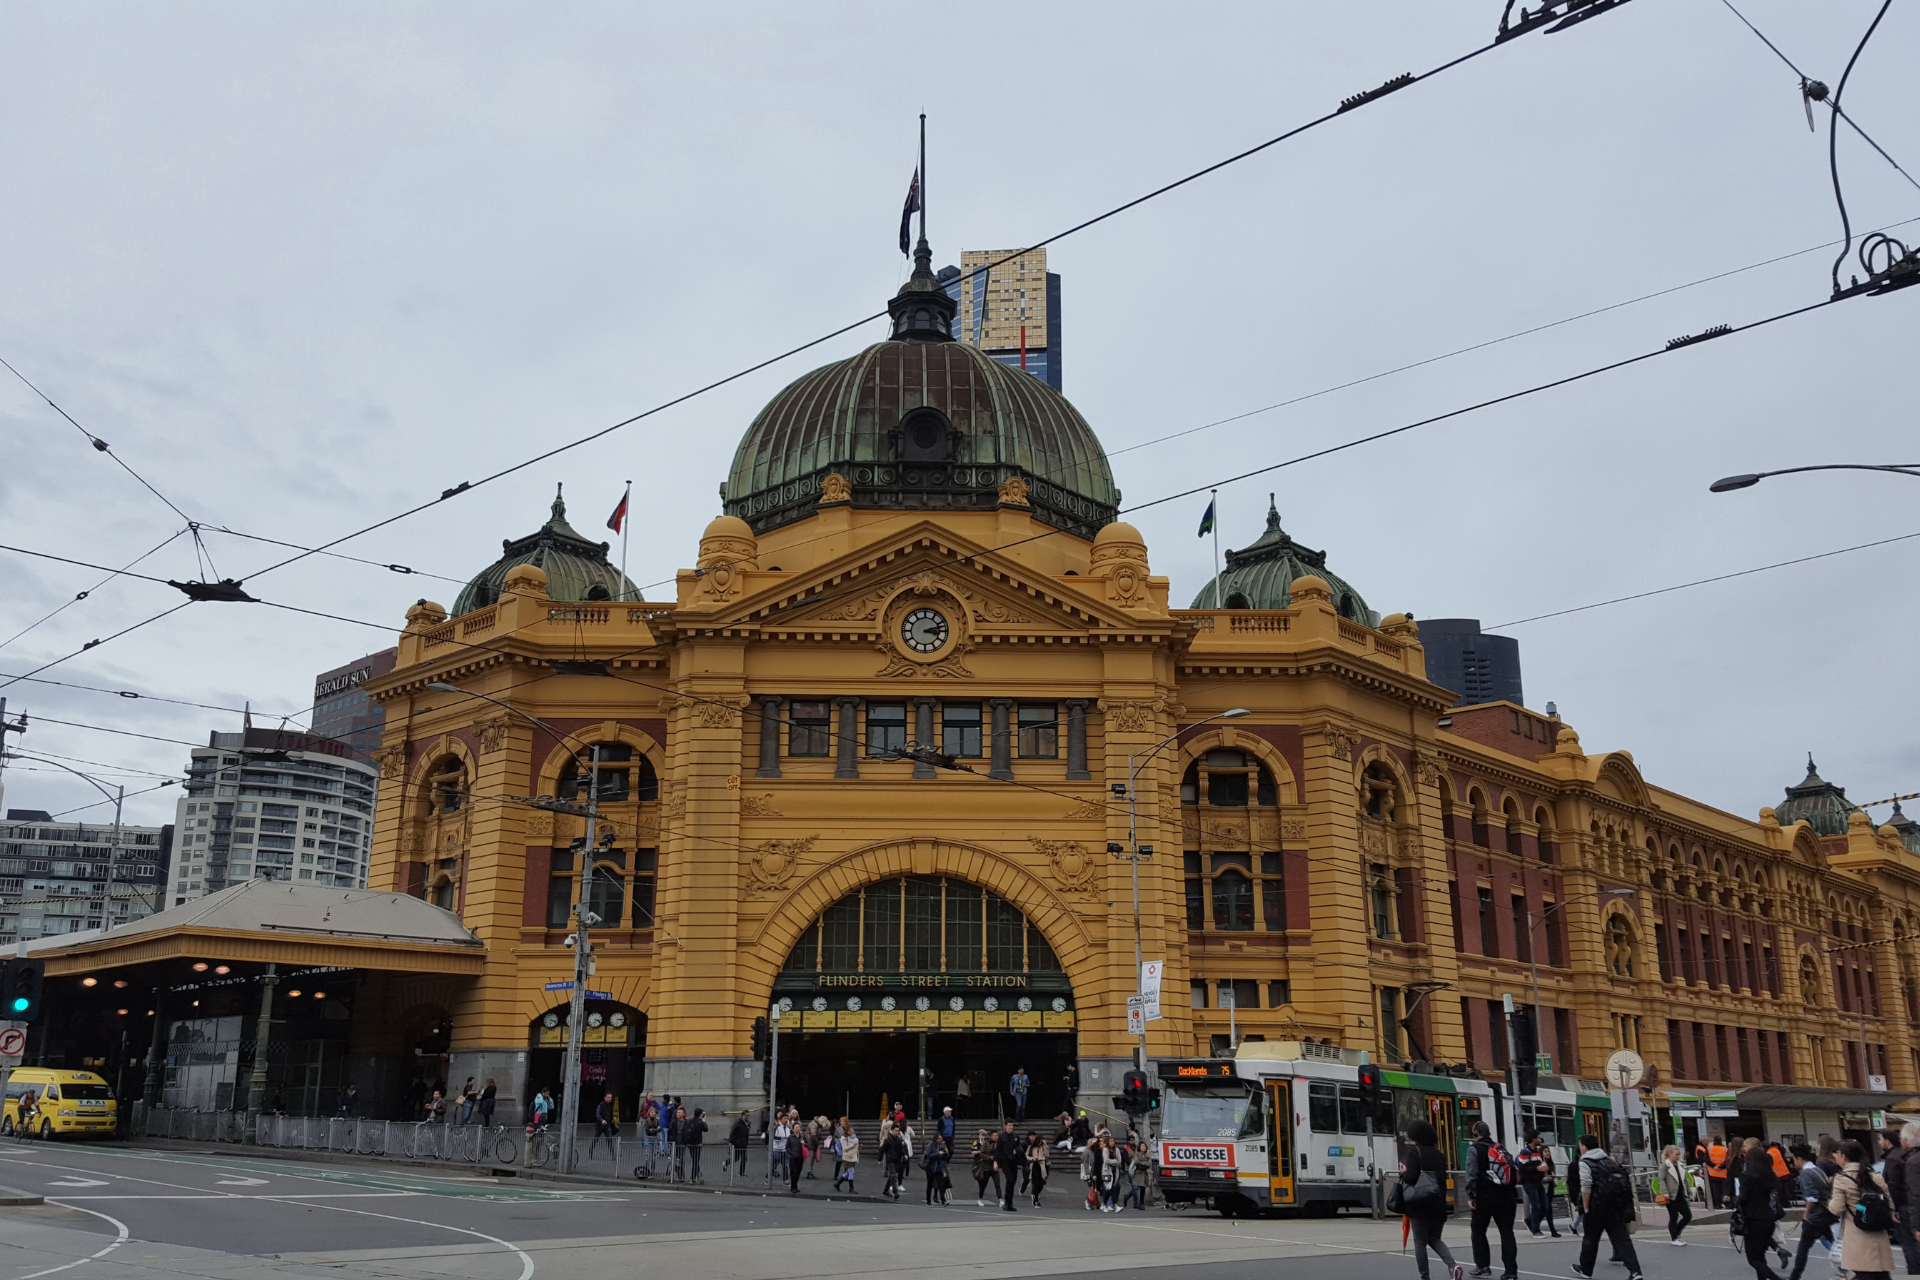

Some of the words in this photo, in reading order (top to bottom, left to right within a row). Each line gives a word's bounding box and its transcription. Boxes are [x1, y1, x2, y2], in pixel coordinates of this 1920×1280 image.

[315, 676, 349, 697] HERALD
[350, 668, 370, 685] SUN
[819, 975, 884, 987] FLINDERS
[901, 975, 950, 987] STREET
[967, 975, 1027, 987] STATION
[1178, 1066, 1208, 1076] Docklands
[1221, 1066, 1230, 1076] 75
[1218, 1128, 1237, 1136] 2085
[1170, 1148, 1227, 1160] SCORSESE
